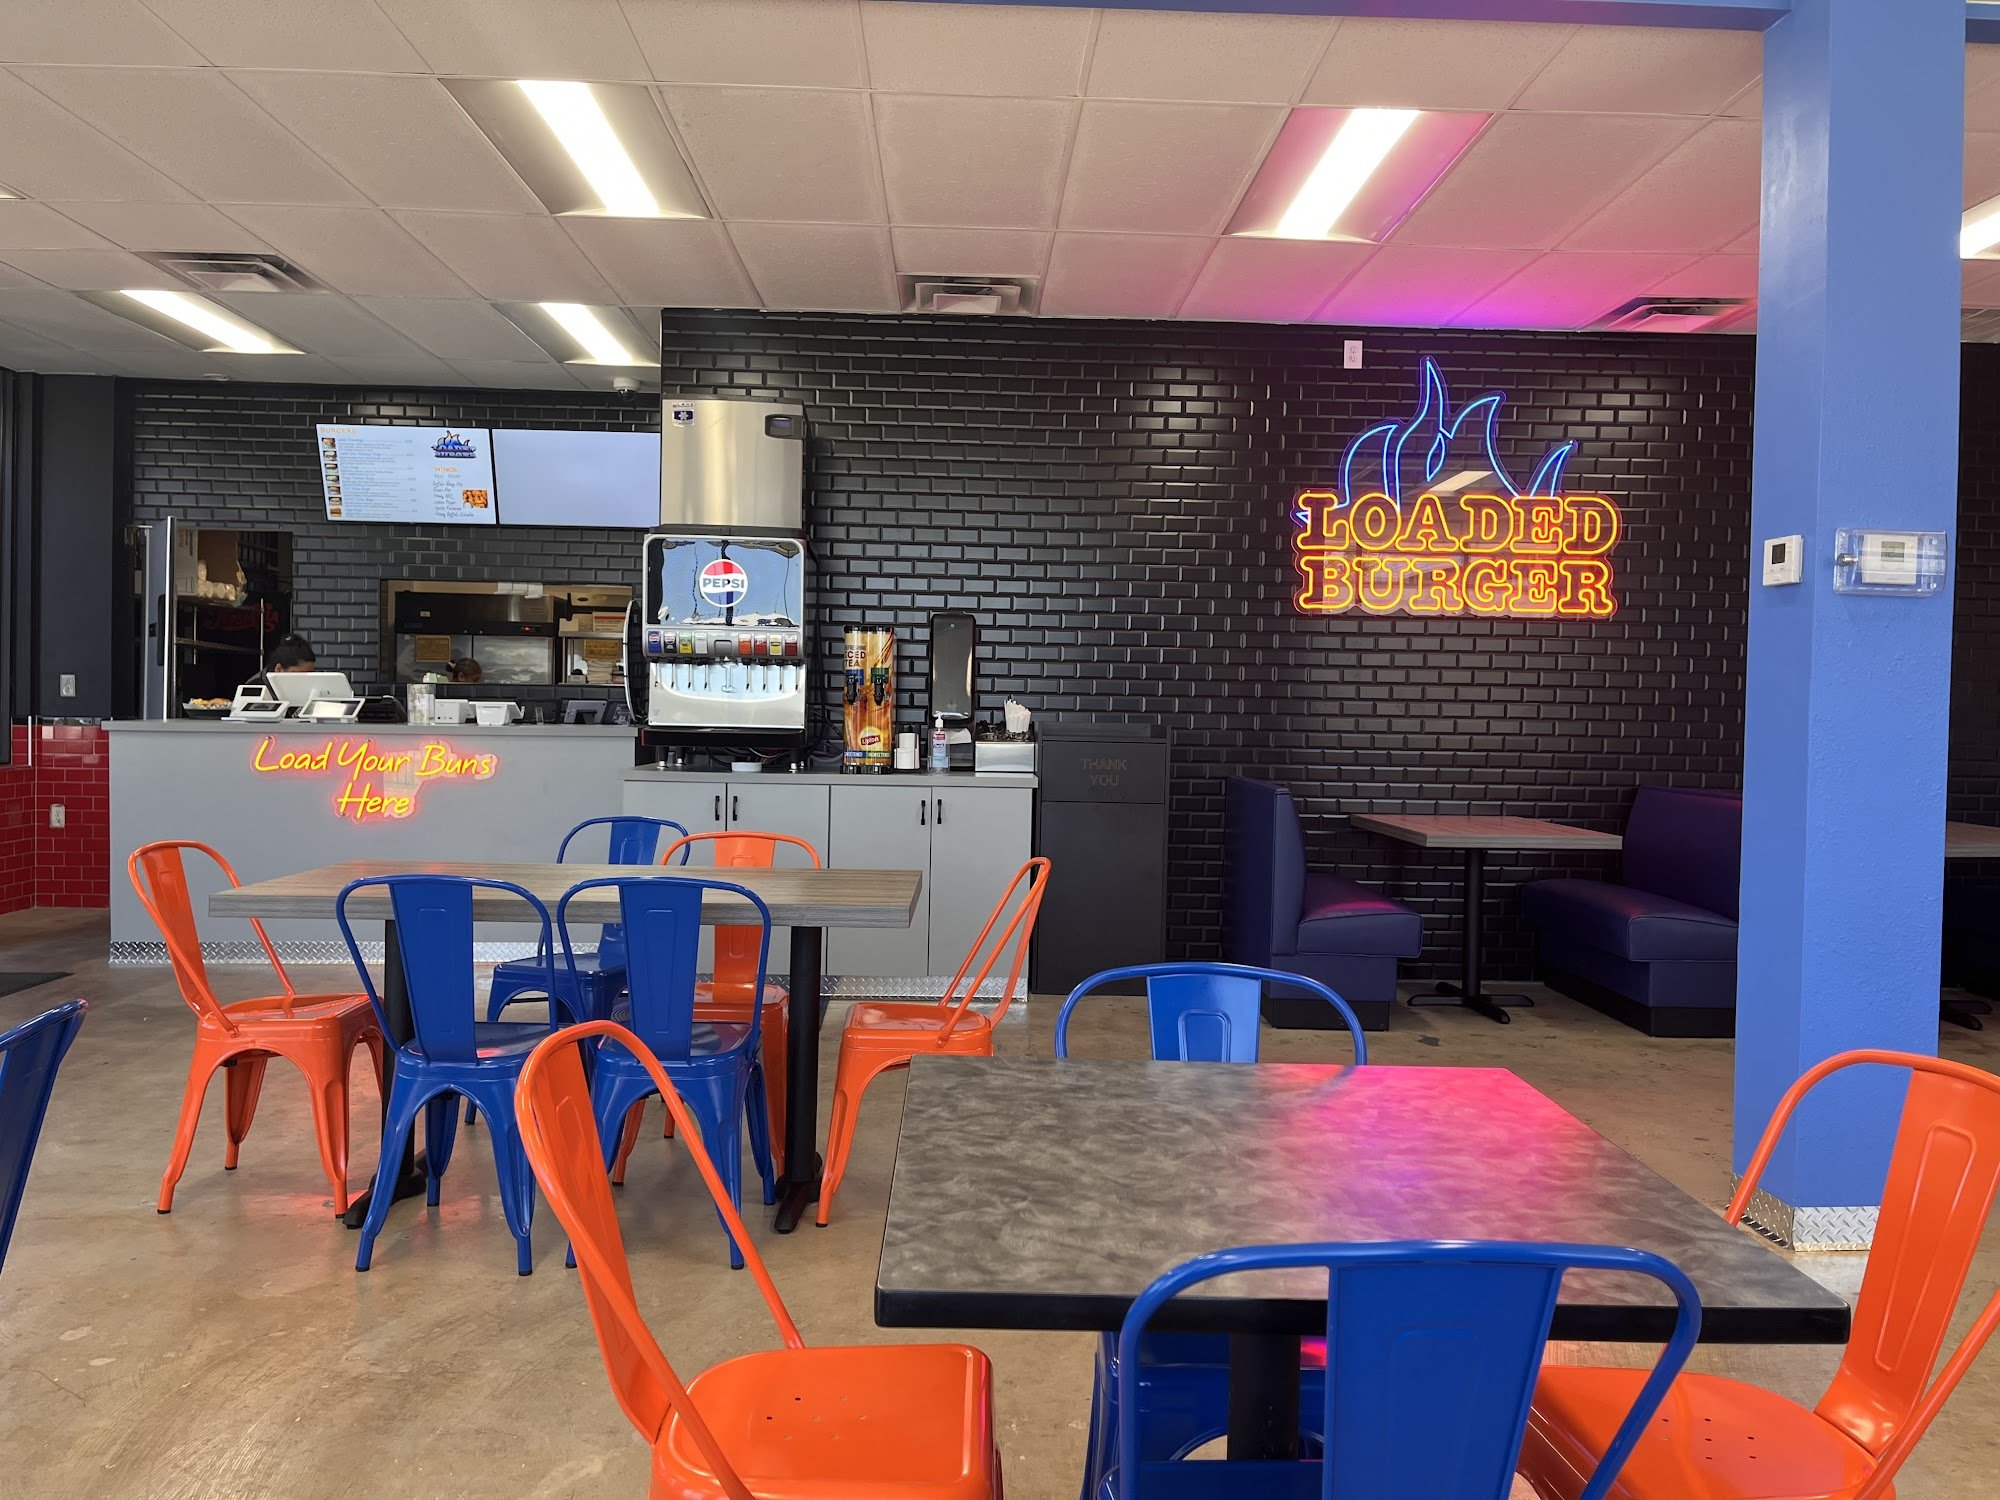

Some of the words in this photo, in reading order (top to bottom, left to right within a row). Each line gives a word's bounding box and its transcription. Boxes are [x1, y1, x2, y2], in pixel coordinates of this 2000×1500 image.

[1296, 492, 1618, 554] LOADED
[702, 577, 745, 589] PEPSI
[1298, 555, 1613, 614] BURGER
[254, 738, 334, 772] Load
[337, 740, 411, 781] Your
[414, 743, 491, 776] Buns
[1080, 759, 1128, 771] THANK
[1089, 774, 1120, 787] YOU
[337, 782, 410, 819] Here
